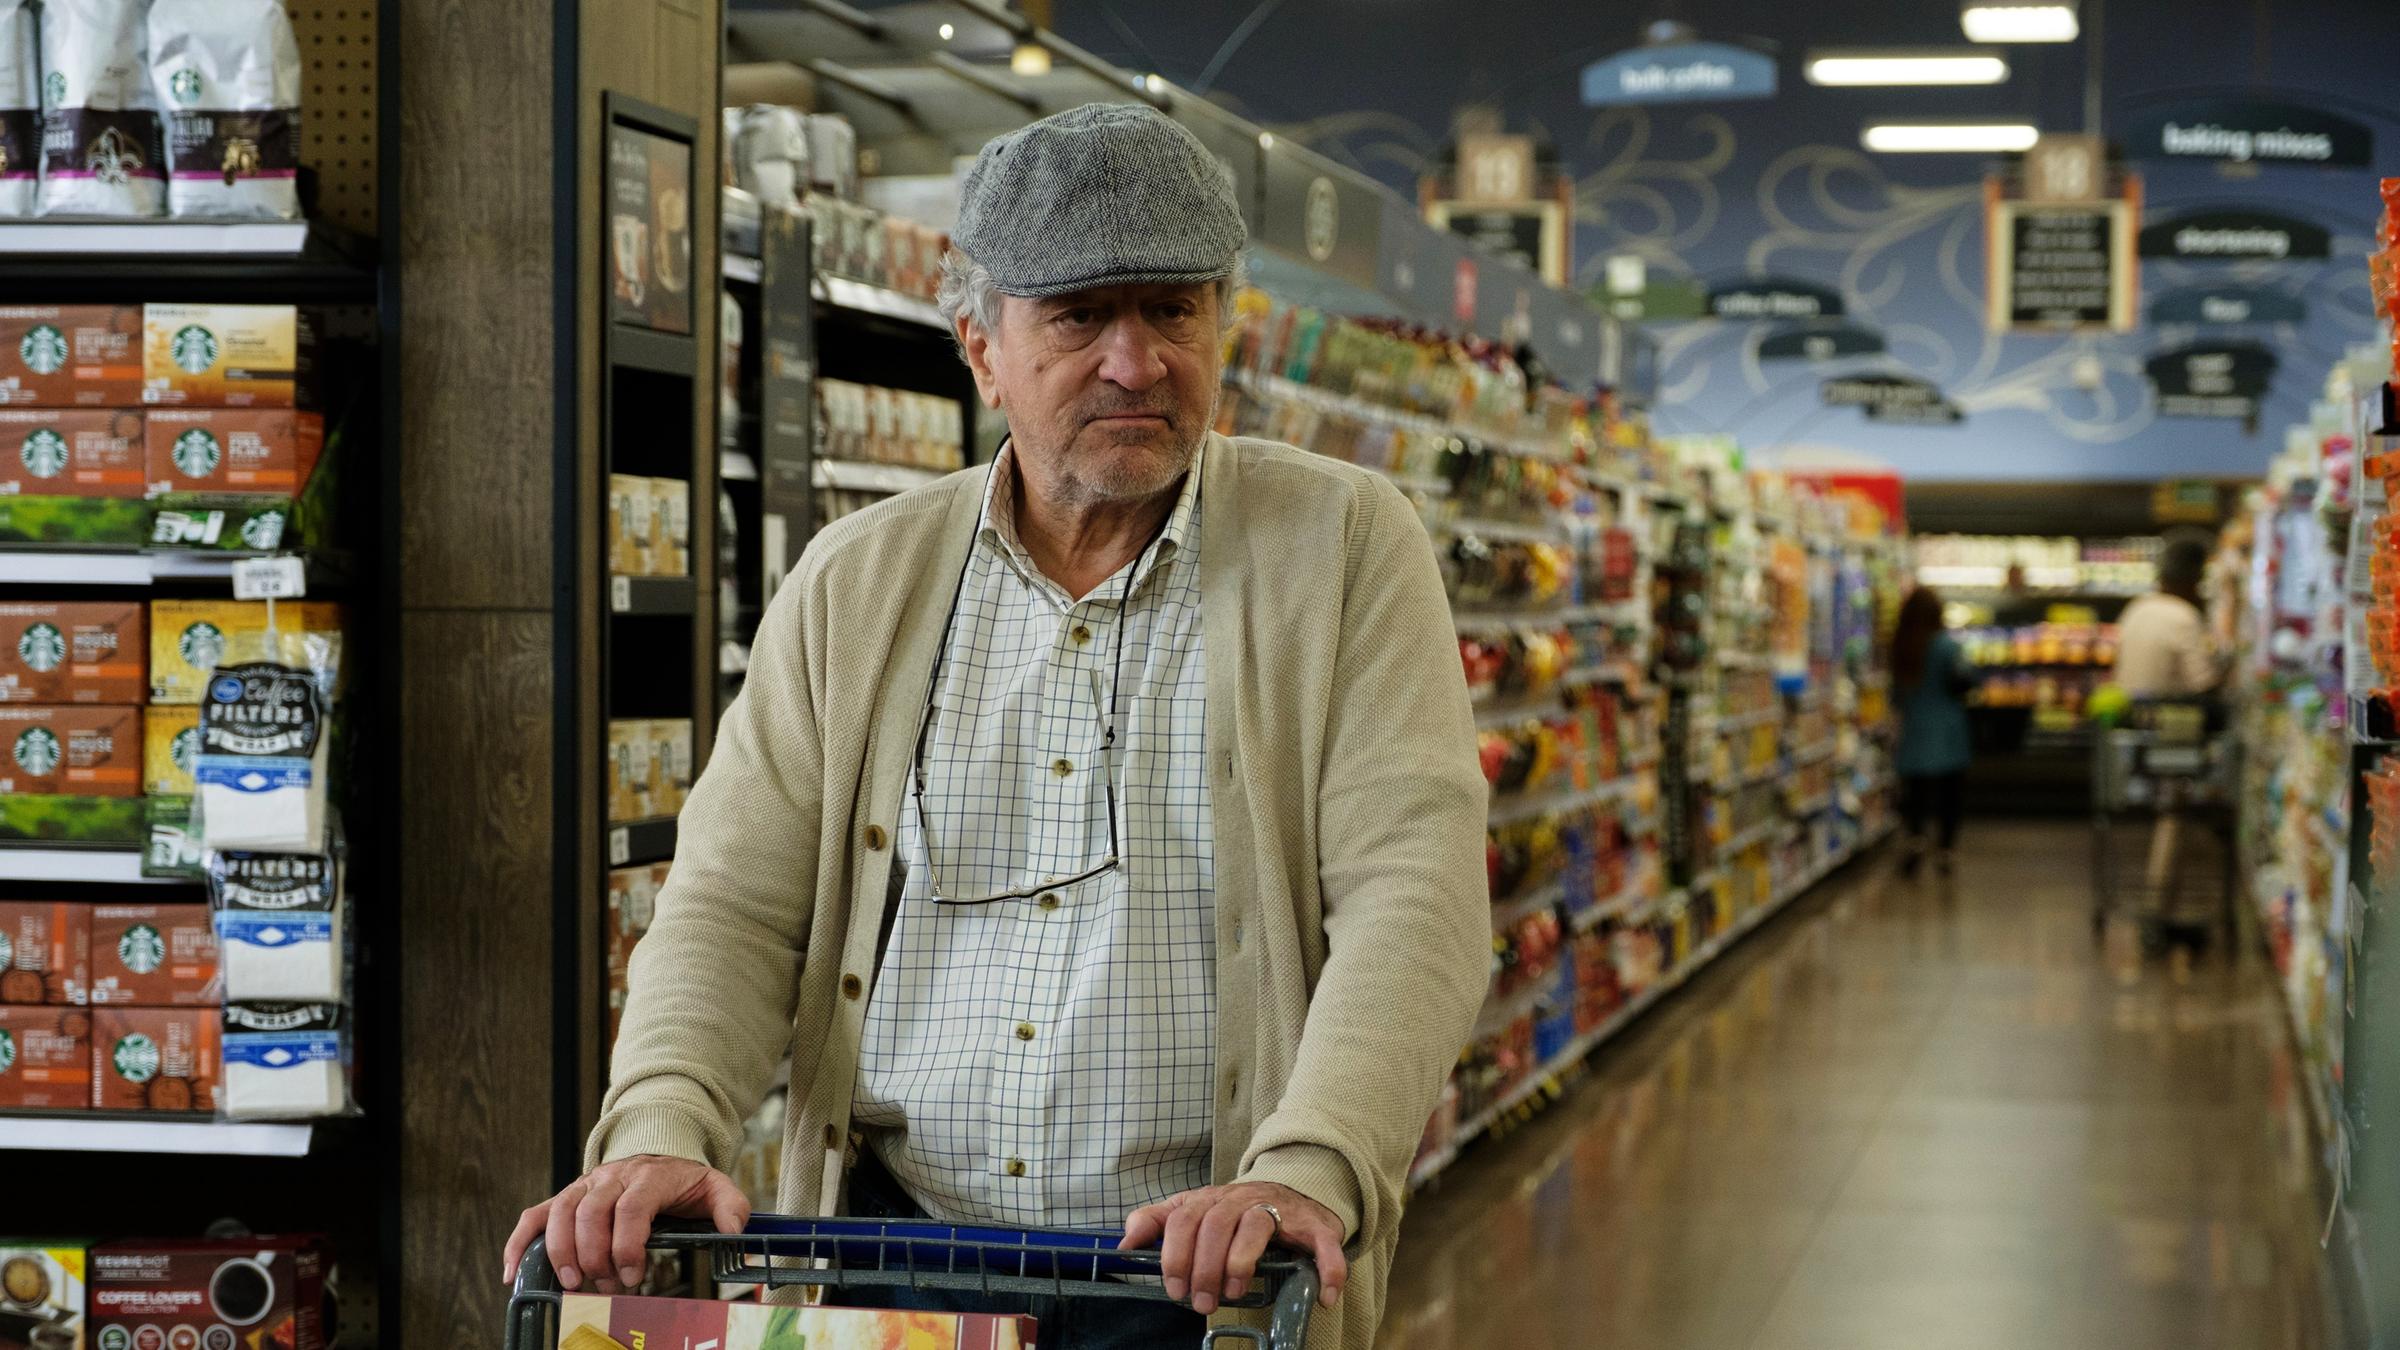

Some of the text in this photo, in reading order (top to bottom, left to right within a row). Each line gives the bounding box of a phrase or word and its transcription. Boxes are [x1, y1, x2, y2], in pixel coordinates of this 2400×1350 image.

[2162, 121, 2333, 161] baking mixes
[73, 633, 118, 648] HOUSE
[244, 678, 306, 707] Coffee
[210, 703, 304, 724] FILTERS
[69, 737, 113, 752] HOUSE
[226, 859, 321, 879] FILTERS
[97, 1291, 147, 1305] COFFEE
[120, 1304, 179, 1314] COLLECTION
